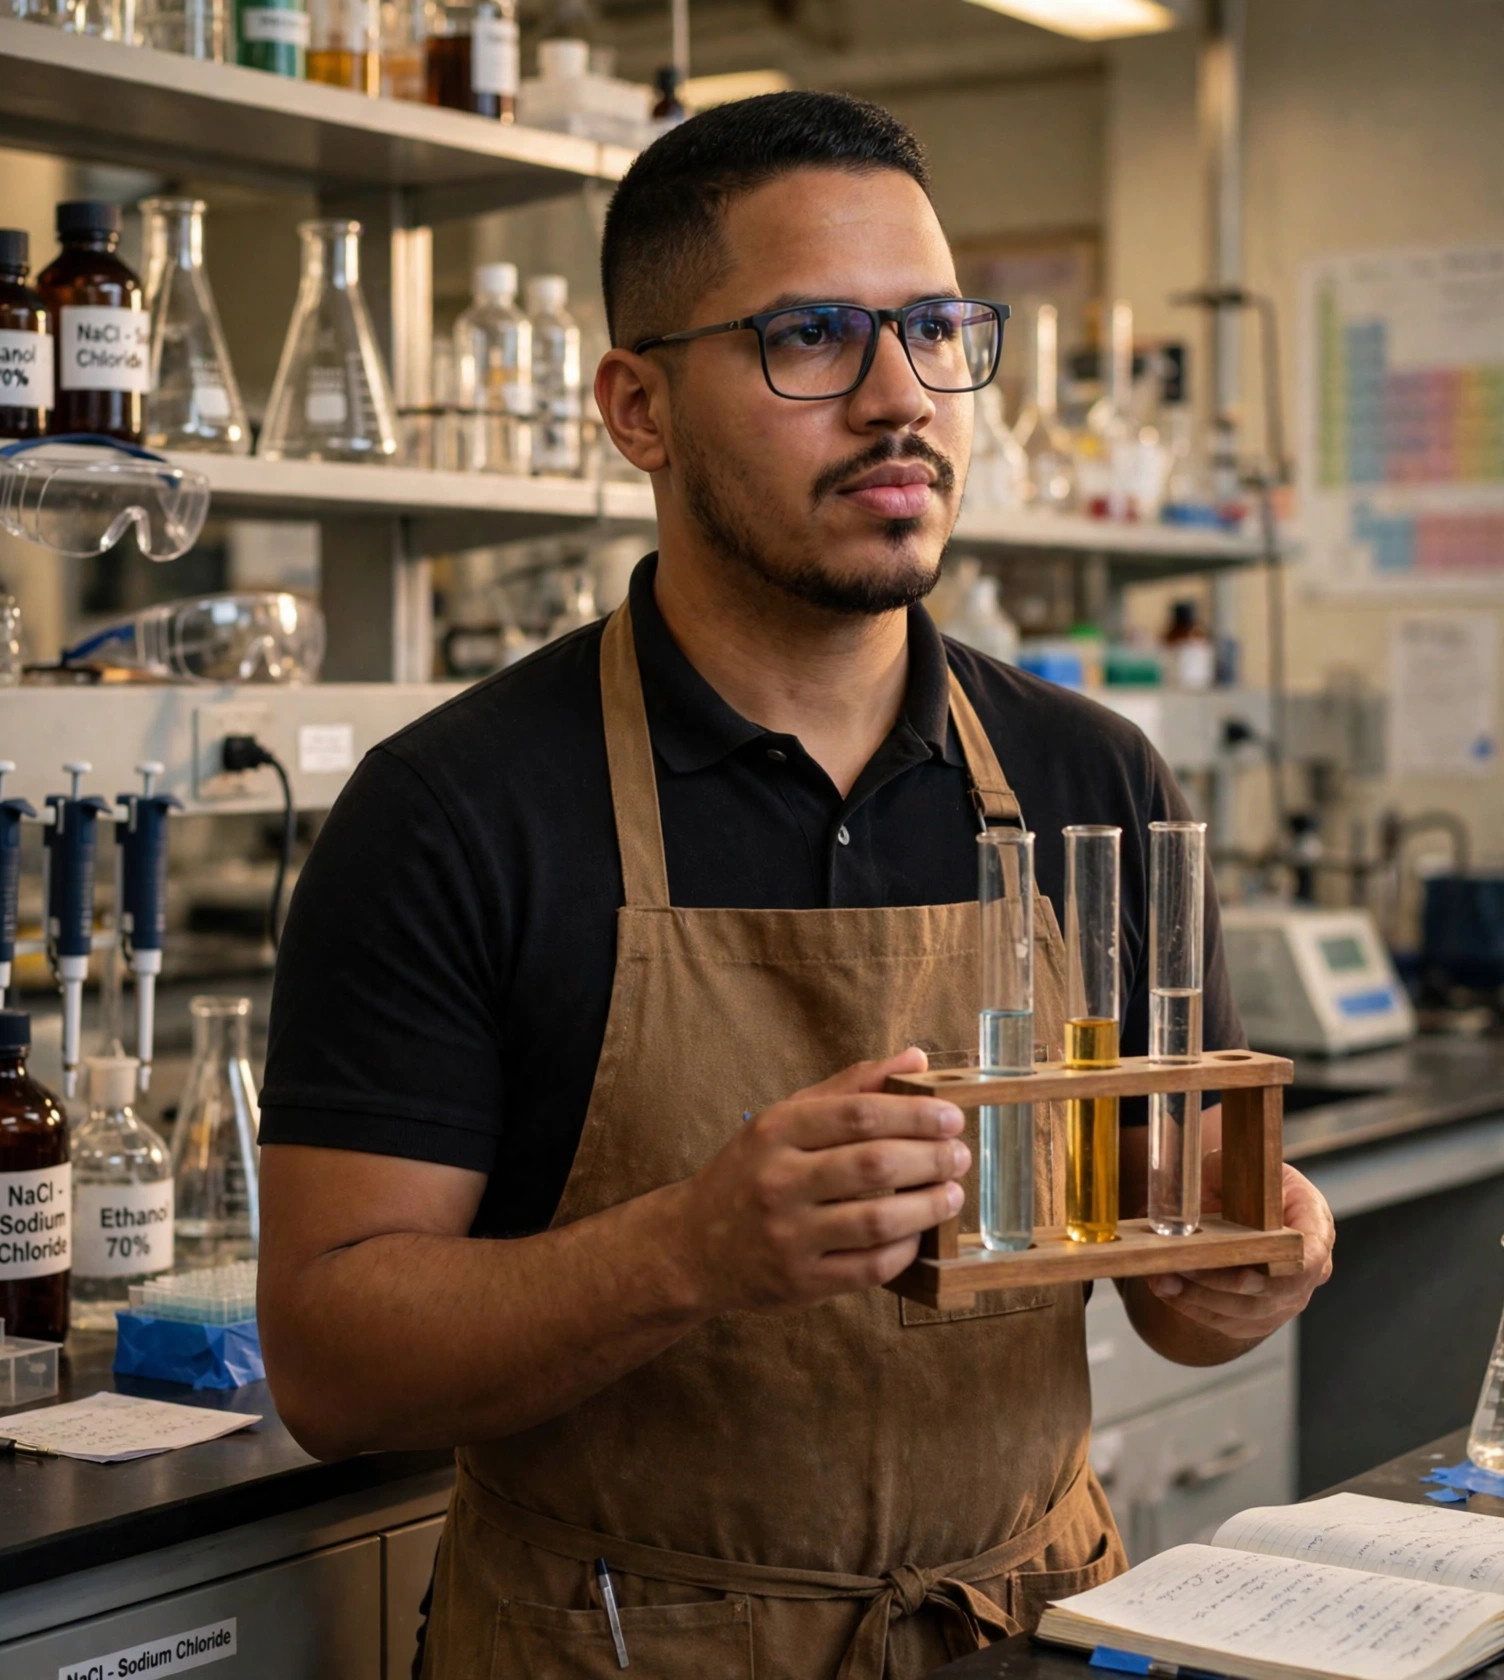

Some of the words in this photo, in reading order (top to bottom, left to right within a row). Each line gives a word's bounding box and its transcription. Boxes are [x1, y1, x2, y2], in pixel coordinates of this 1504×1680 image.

[77, 323, 120, 342] NaCl
[0, 367, 29, 387] 0%
[8, 1181, 53, 1207] NaCl
[0, 1211, 66, 1235] Sodium
[101, 1200, 169, 1228] Ethanol
[0, 1235, 67, 1263] Chloride
[106, 1233, 150, 1258] 70%
[118, 1651, 172, 1678] Sodium
[176, 1628, 231, 1660] Chloride
